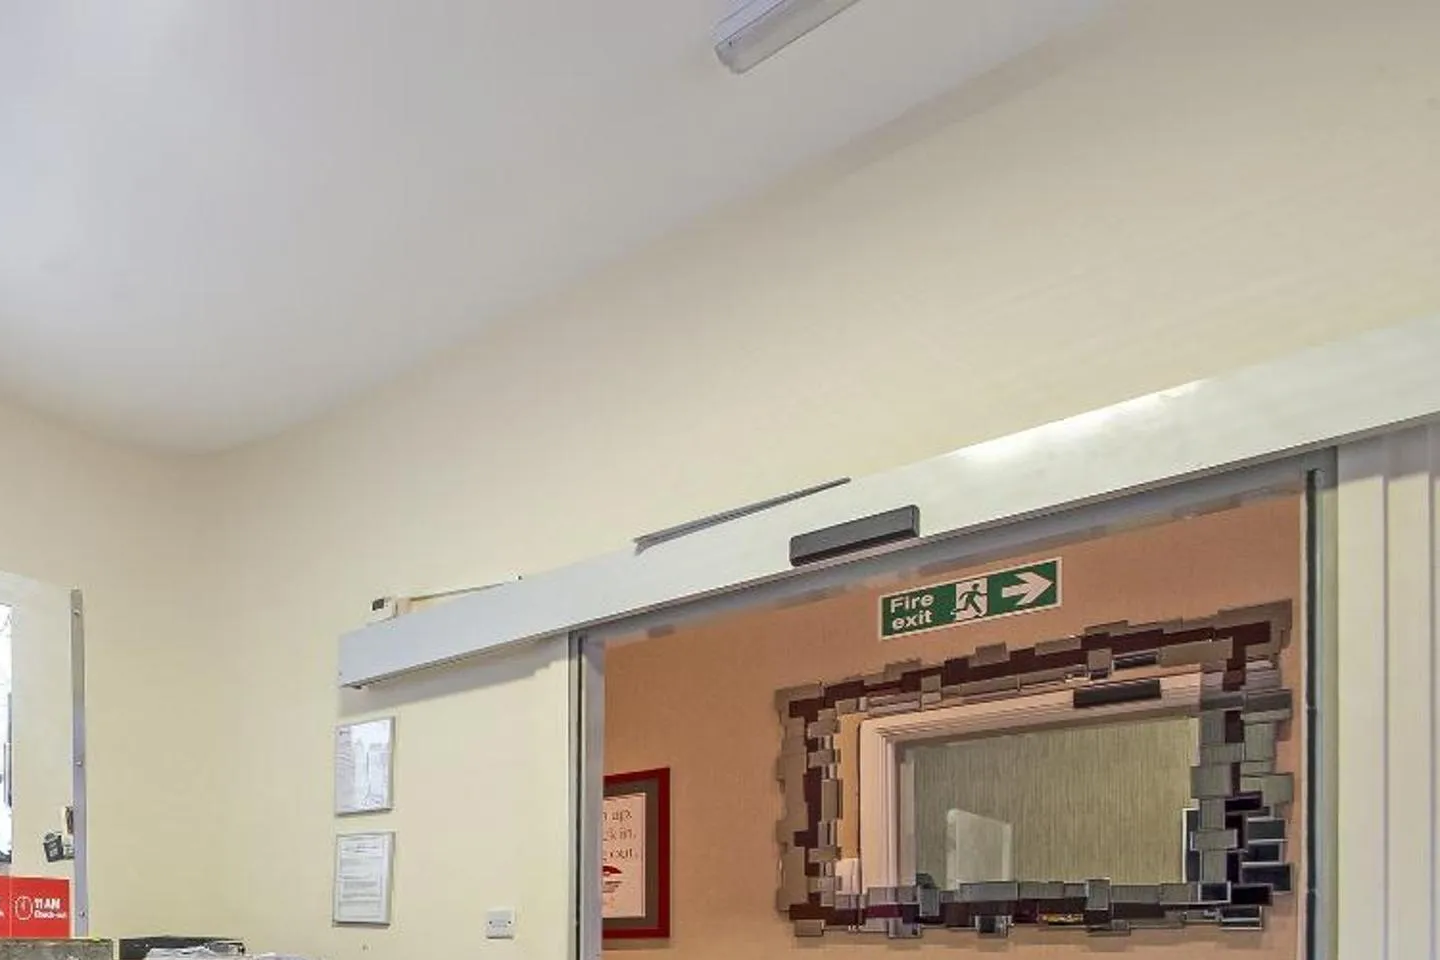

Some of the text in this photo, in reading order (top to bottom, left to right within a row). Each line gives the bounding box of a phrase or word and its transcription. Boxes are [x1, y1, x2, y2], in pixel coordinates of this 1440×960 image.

[890, 594, 934, 613] Fire
[892, 610, 933, 630] exit
[34, 898, 61, 909] 11 AM
